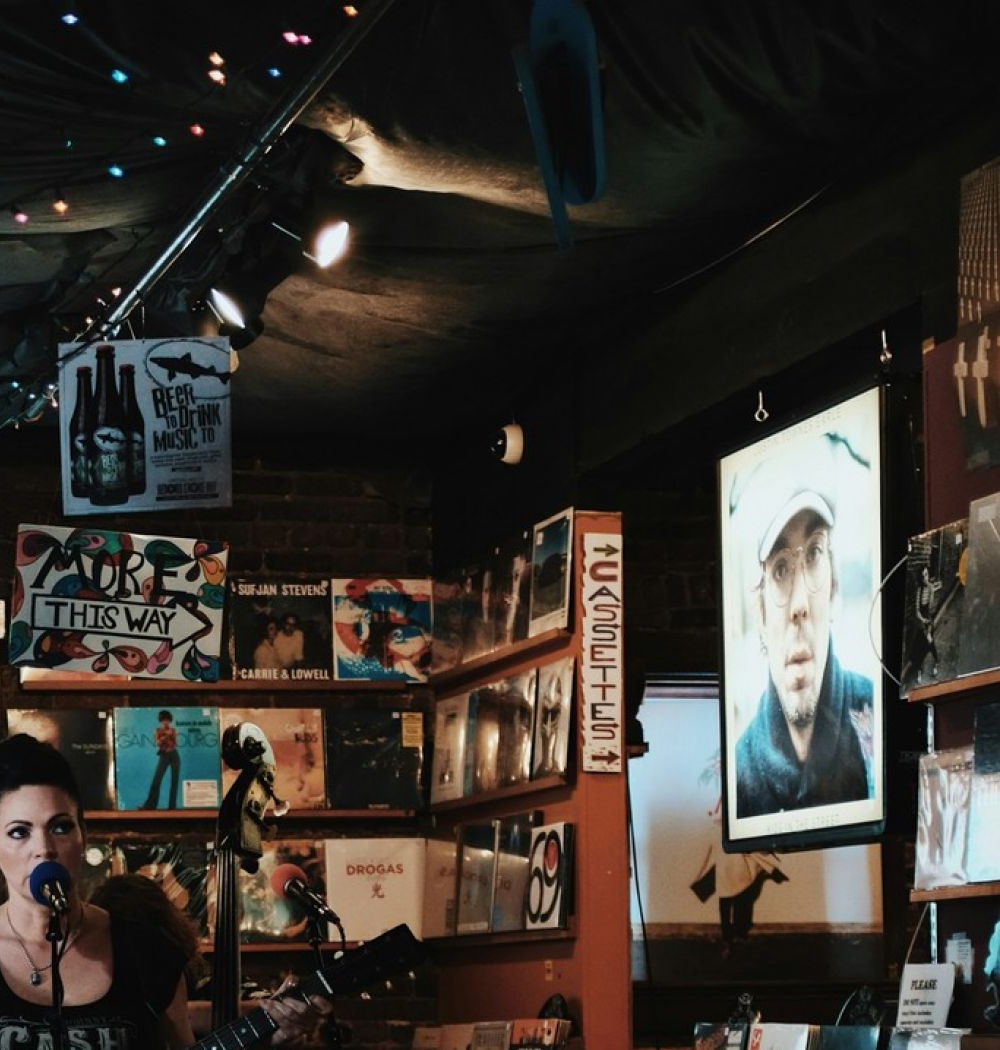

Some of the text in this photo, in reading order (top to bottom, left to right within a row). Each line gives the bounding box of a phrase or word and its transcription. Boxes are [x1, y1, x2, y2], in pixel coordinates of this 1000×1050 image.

[166, 414, 177, 429] TO
[201, 427, 216, 443] TO
[31, 545, 179, 605] MORE
[238, 582, 328, 596] SUFJAN STEVENS
[45, 599, 177, 636] THIS WAY
[588, 562, 621, 741] CASSETTES
[241, 667, 331, 680] CARRIE & LOWELL
[346, 863, 404, 876] DROGAS
[910, 978, 938, 991] PLEASE
